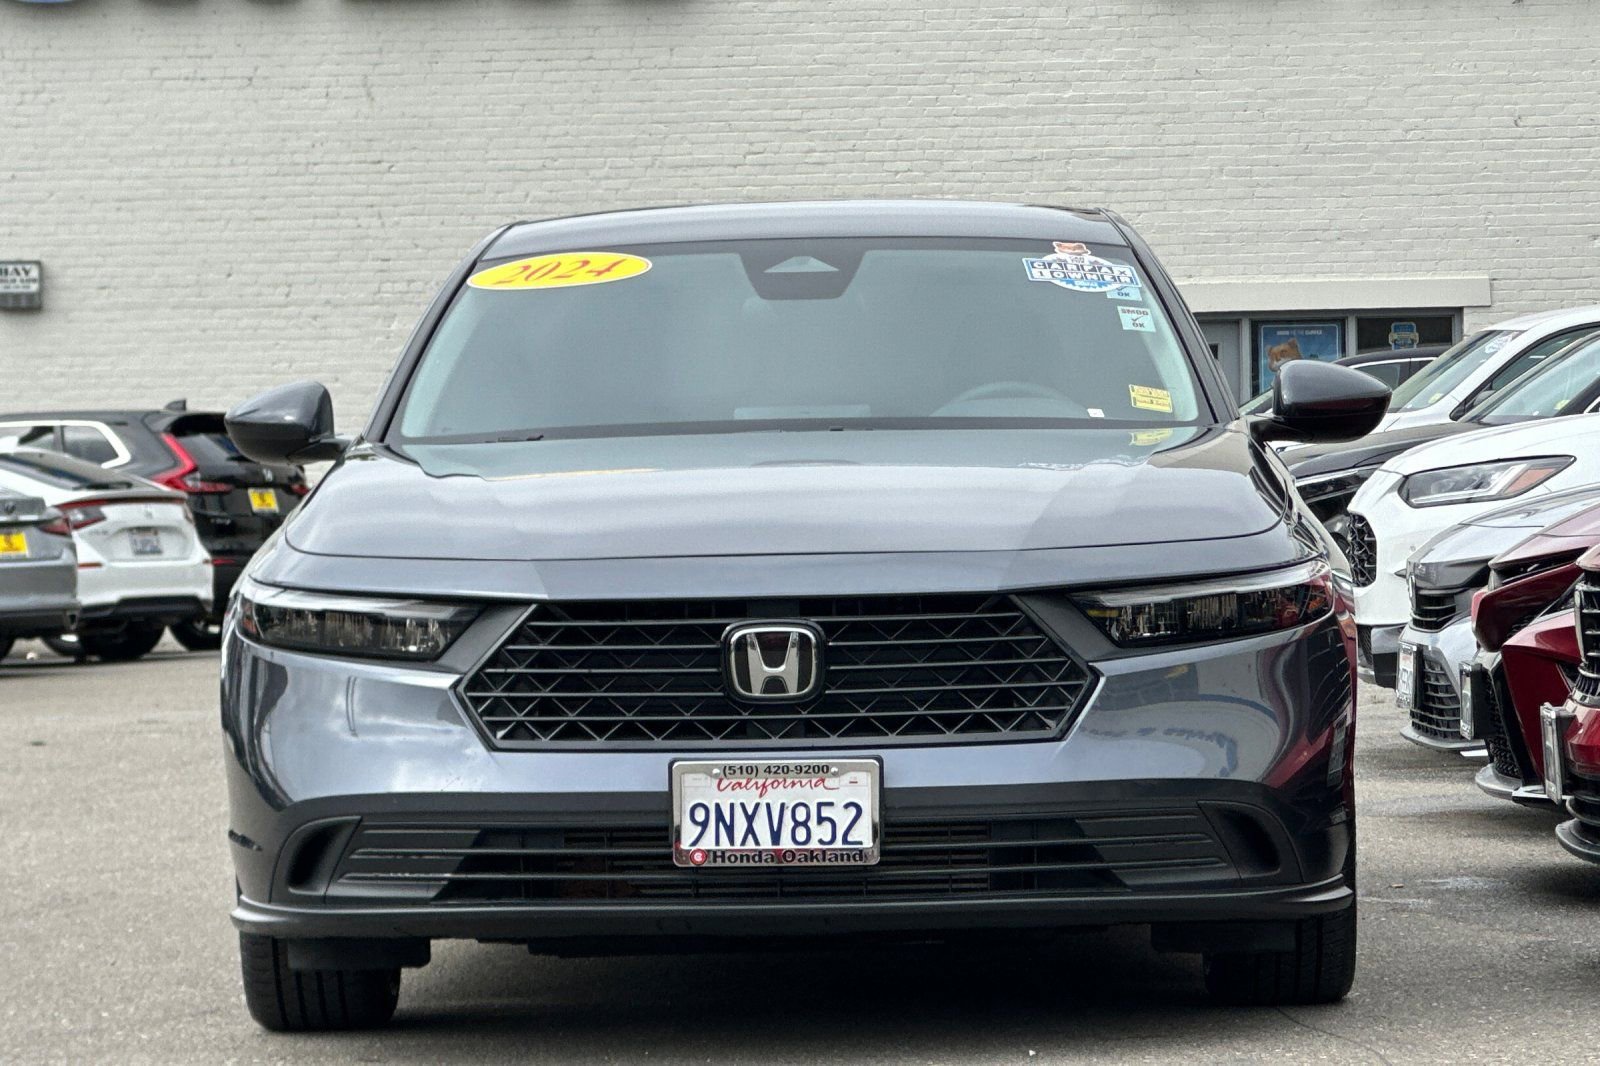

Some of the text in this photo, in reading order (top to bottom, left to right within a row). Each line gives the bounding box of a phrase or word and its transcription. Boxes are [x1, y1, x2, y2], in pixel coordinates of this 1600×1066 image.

[492, 258, 628, 285] 2024
[1031, 262, 1128, 276] CARFAX
[1051, 271, 1133, 283] OWNER
[722, 764, 830, 777] (510) 420-9200
[716, 777, 841, 799] California
[688, 801, 864, 847] 9NXV852
[711, 849, 864, 864] Honda Oakland
